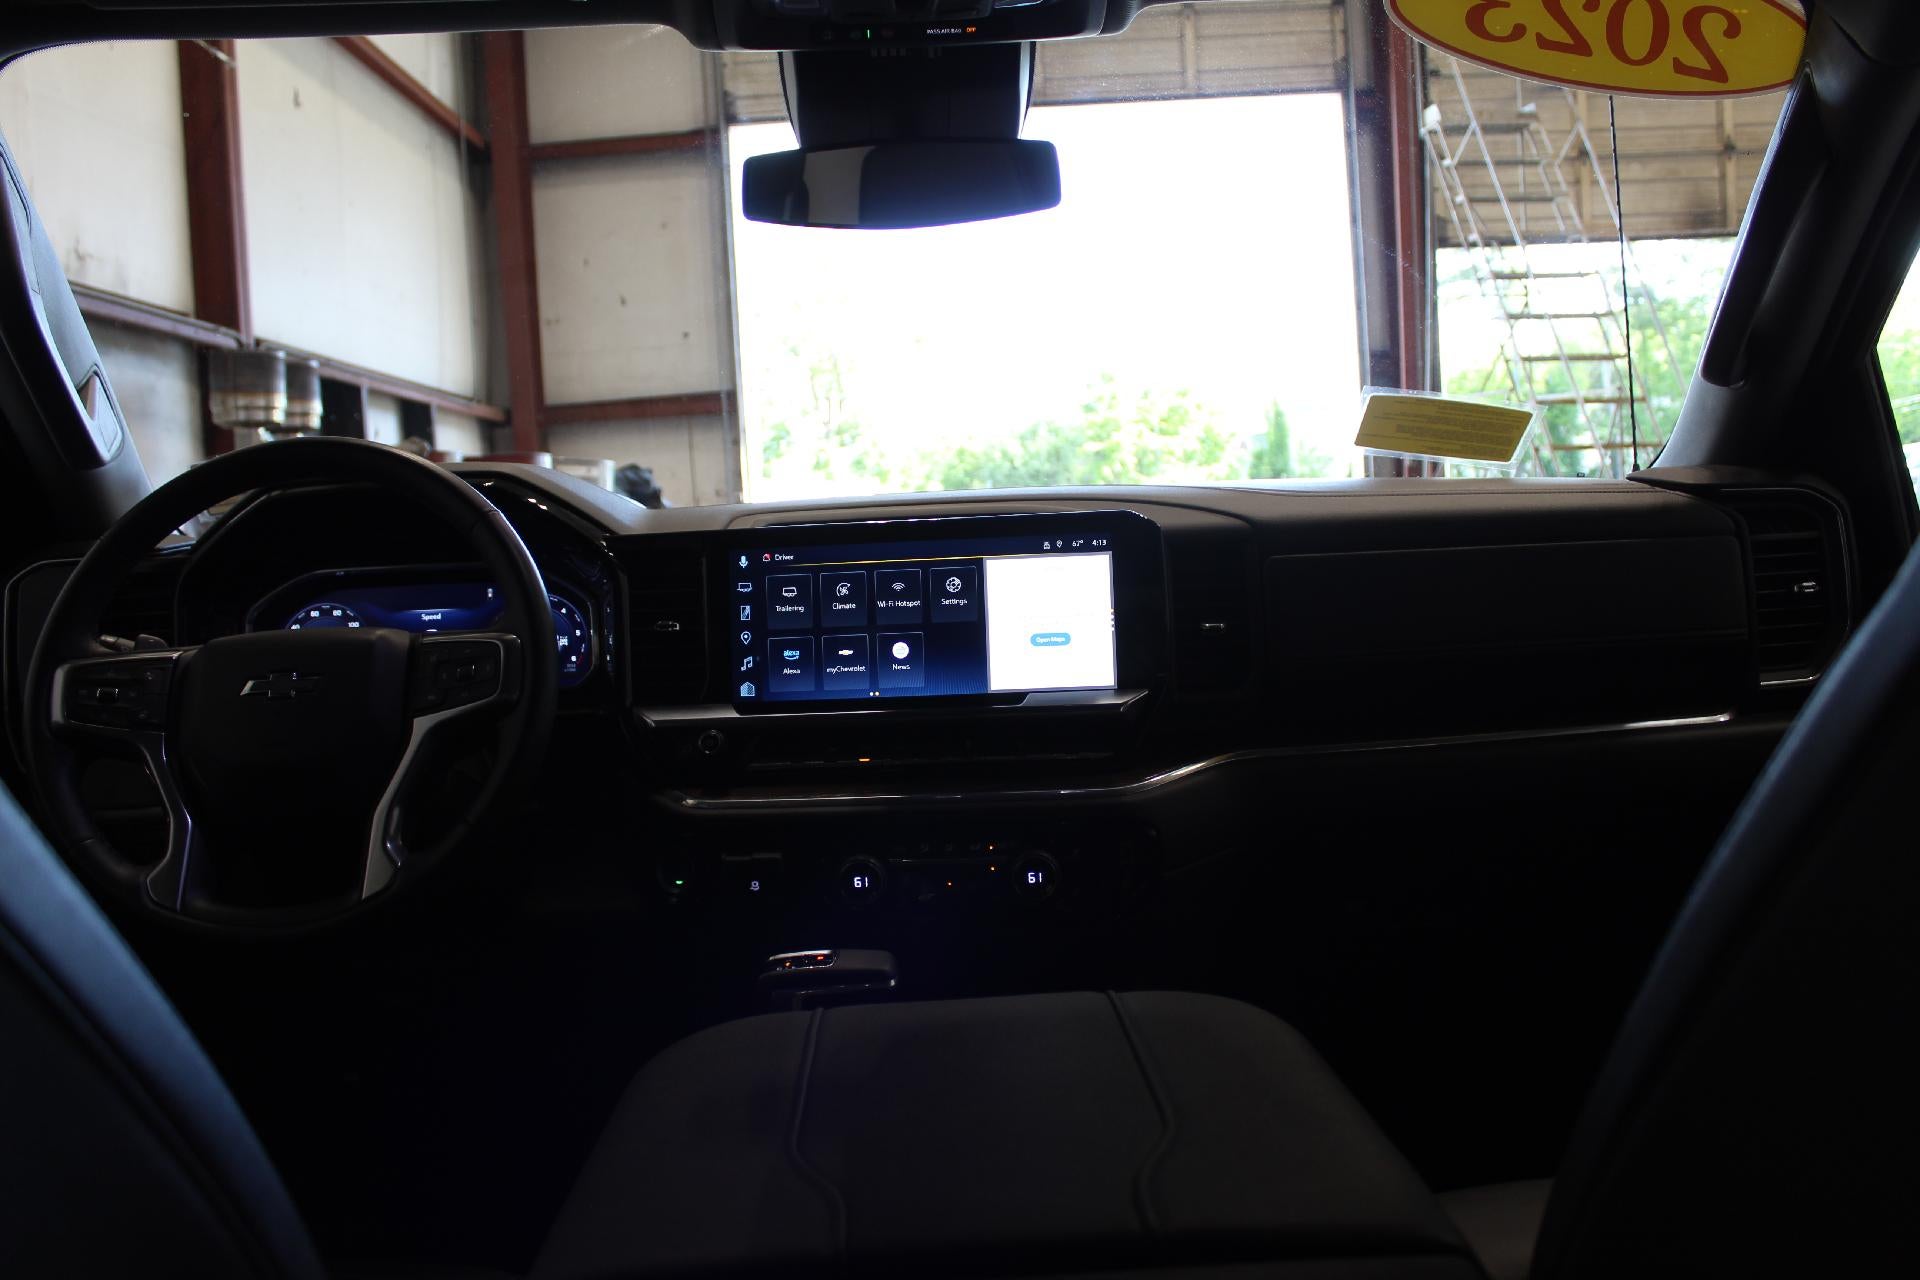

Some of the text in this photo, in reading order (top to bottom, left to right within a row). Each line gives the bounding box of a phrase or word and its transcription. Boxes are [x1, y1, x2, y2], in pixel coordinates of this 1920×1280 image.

[774, 553, 794, 561] Driver
[832, 602, 856, 610] Climate
[877, 600, 920, 608] Wi-Fi Hotspot
[941, 598, 968, 606] Settings
[776, 604, 804, 613] Trailering
[421, 612, 442, 622] Speed
[575, 629, 581, 637] 5
[1051, 636, 1065, 644] Maps
[783, 649, 800, 657] alexa
[827, 665, 866, 674] myChevrolet
[854, 876, 869, 888] 61
[1027, 872, 1042, 884] 61
